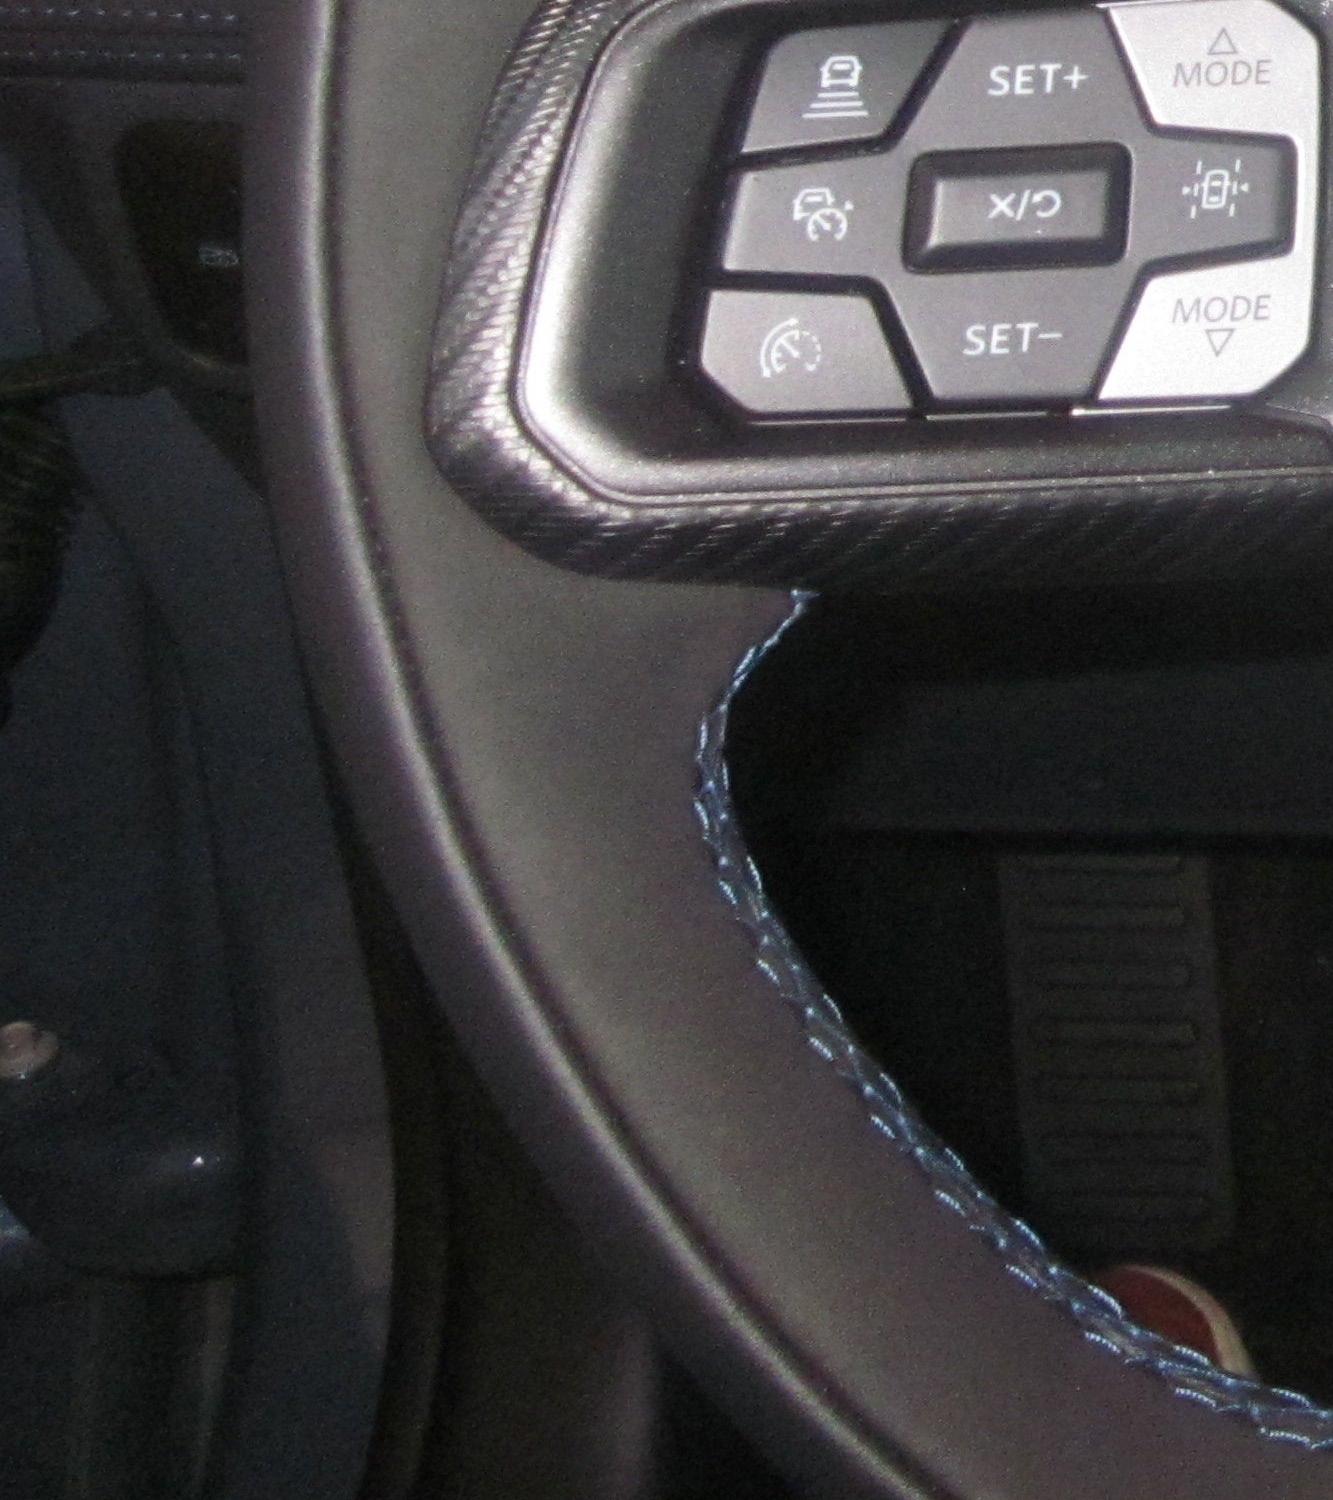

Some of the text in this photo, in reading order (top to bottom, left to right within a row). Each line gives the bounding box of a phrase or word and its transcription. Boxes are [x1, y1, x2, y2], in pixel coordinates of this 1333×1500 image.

[986, 63, 1089, 97] SET+
[1171, 59, 1274, 89] MODE
[1170, 293, 1272, 325] MODE
